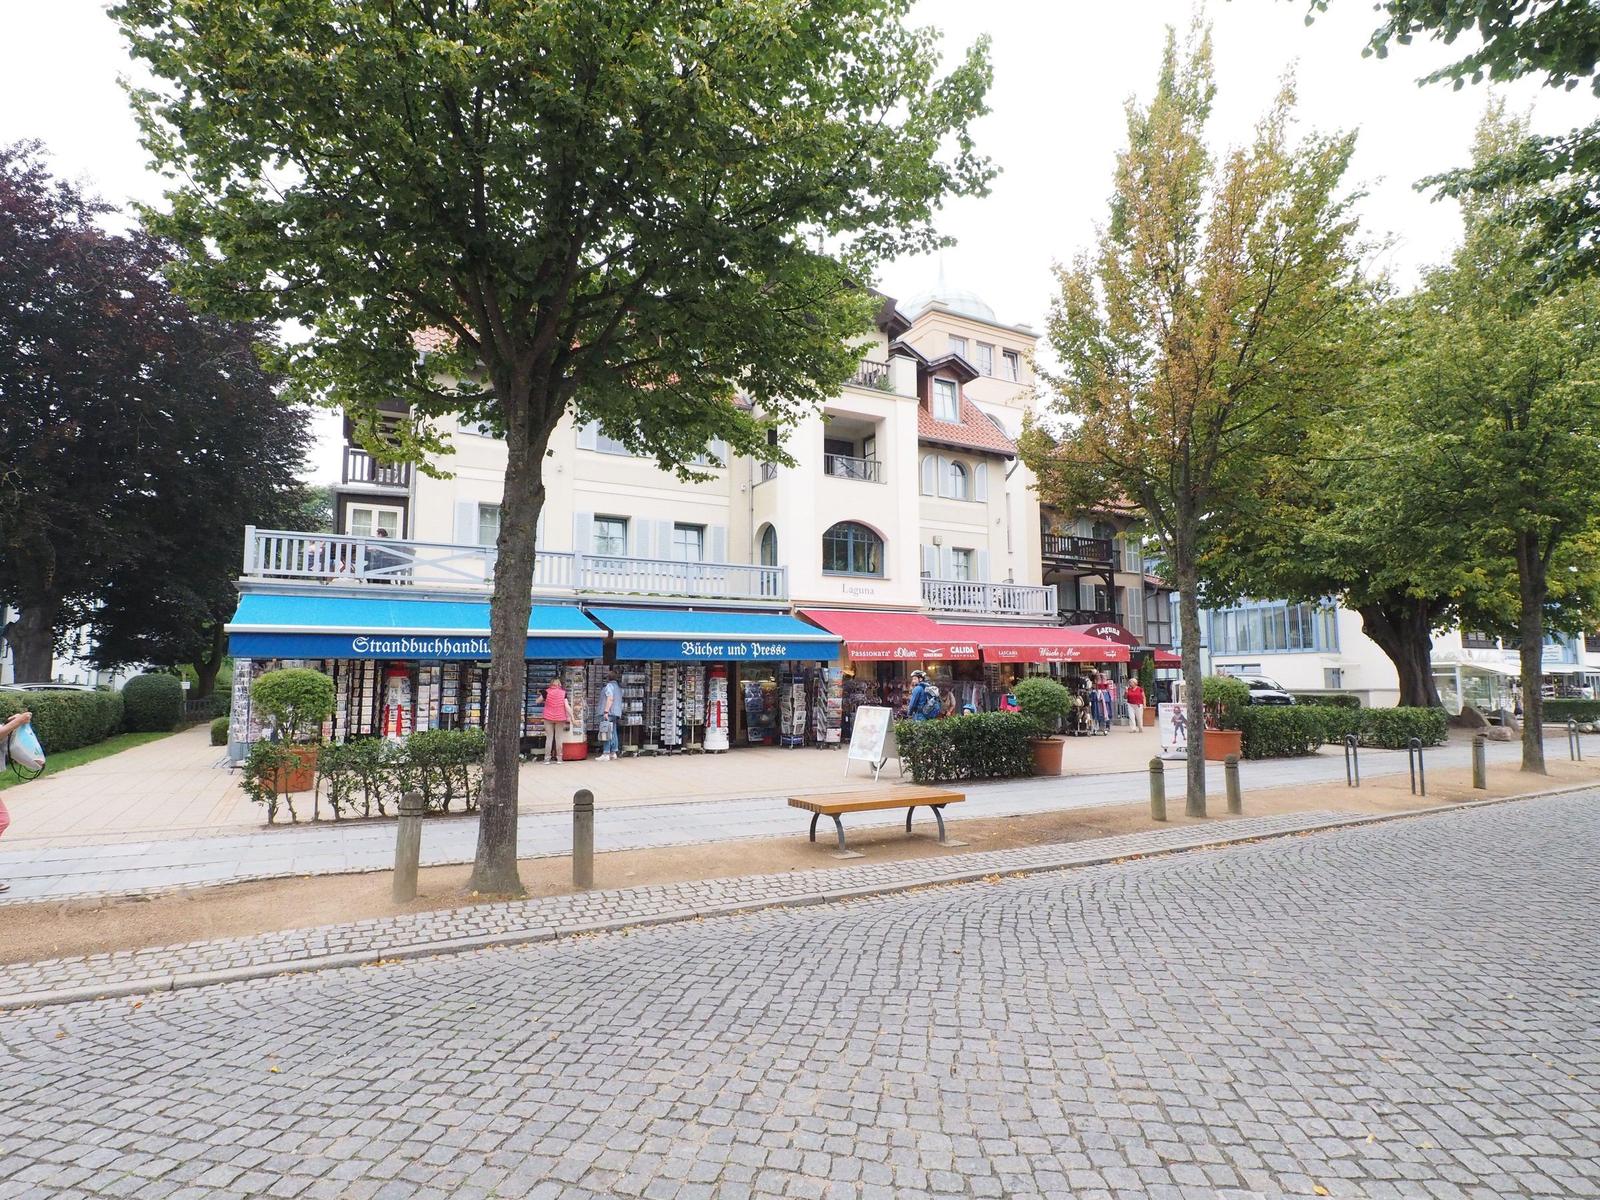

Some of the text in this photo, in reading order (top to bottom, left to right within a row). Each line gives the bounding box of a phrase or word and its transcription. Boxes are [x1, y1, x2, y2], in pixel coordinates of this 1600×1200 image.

[842, 583, 874, 597] Laguna
[1096, 626, 1120, 637] Laguna
[352, 636, 491, 656] Strandbuchhandlu
[681, 641, 787, 657] Bücher und Presse
[950, 646, 975, 654] CALIDA
